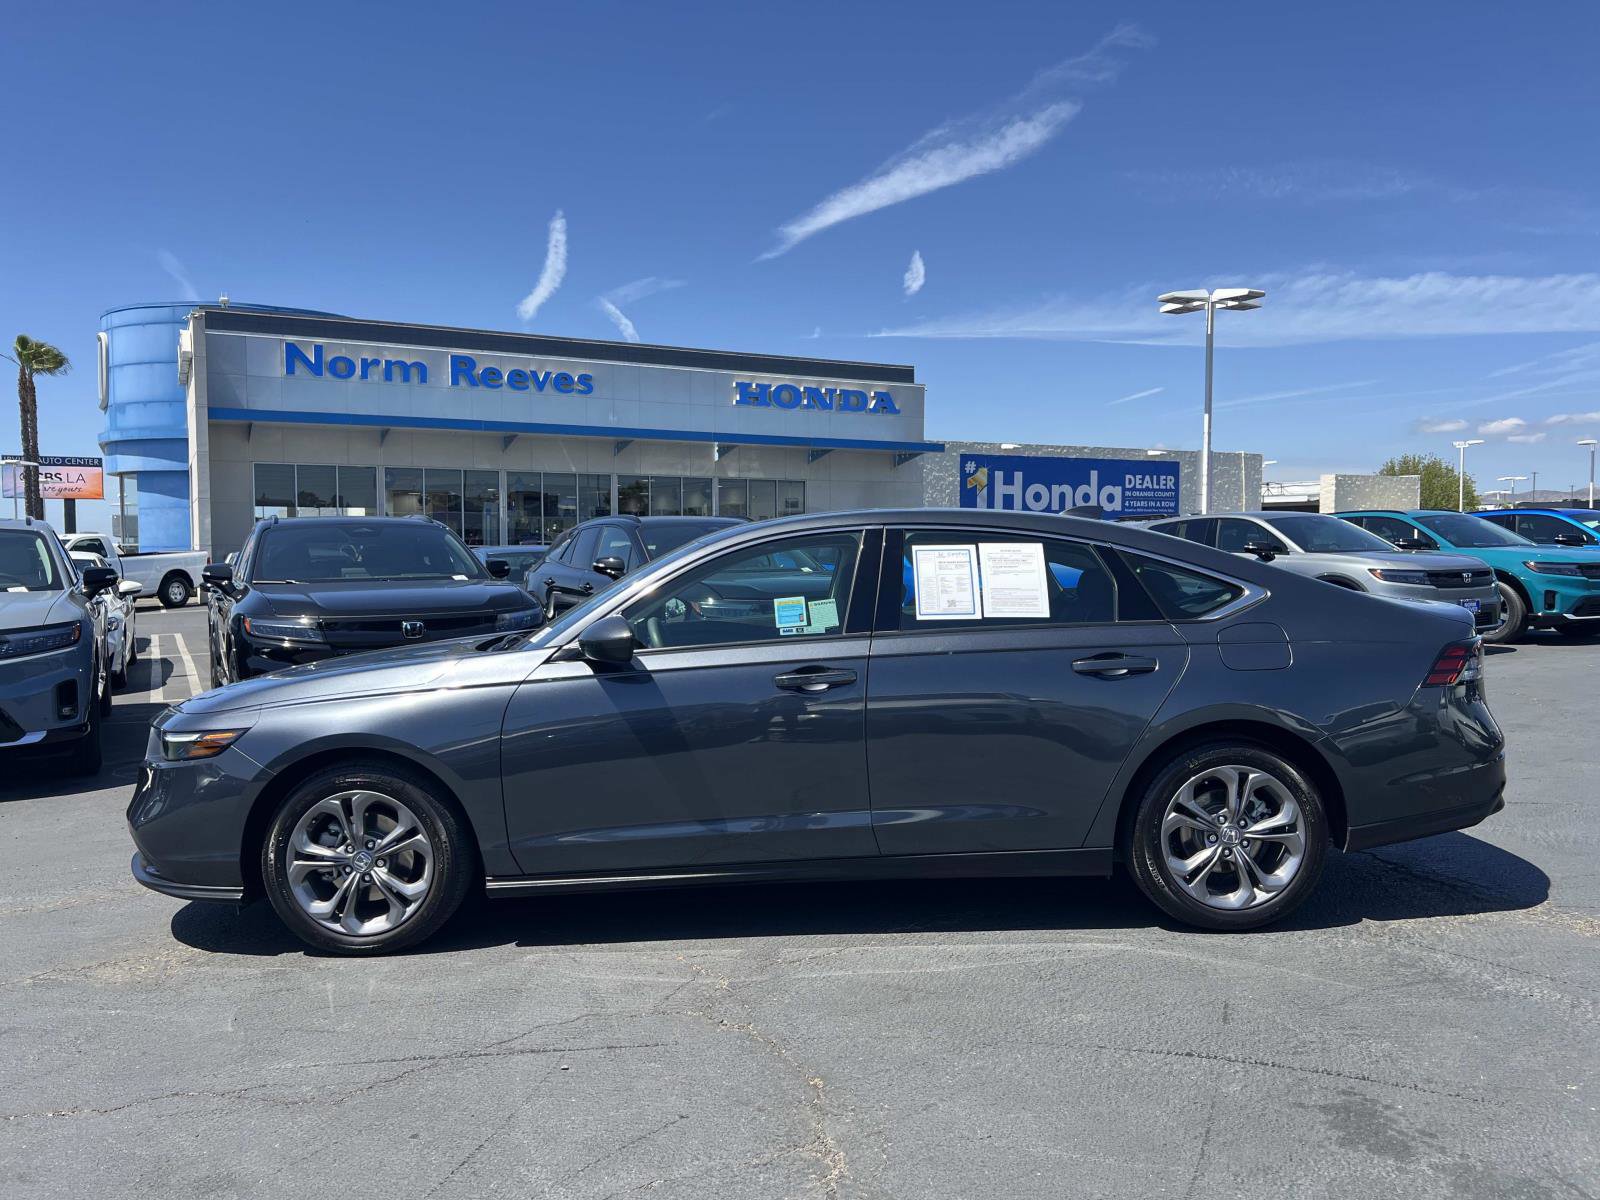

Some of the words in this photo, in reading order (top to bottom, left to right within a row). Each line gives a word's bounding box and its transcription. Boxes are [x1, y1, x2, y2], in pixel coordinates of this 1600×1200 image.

[284, 342, 428, 384] Norm
[449, 354, 594, 395] Reeves
[733, 382, 901, 415] HONDA
[38, 457, 62, 465] AUTO
[65, 458, 99, 466] CENTER
[66, 472, 86, 483] LA
[1125, 474, 1175, 489] DEALER
[995, 470, 1122, 512] Honda
